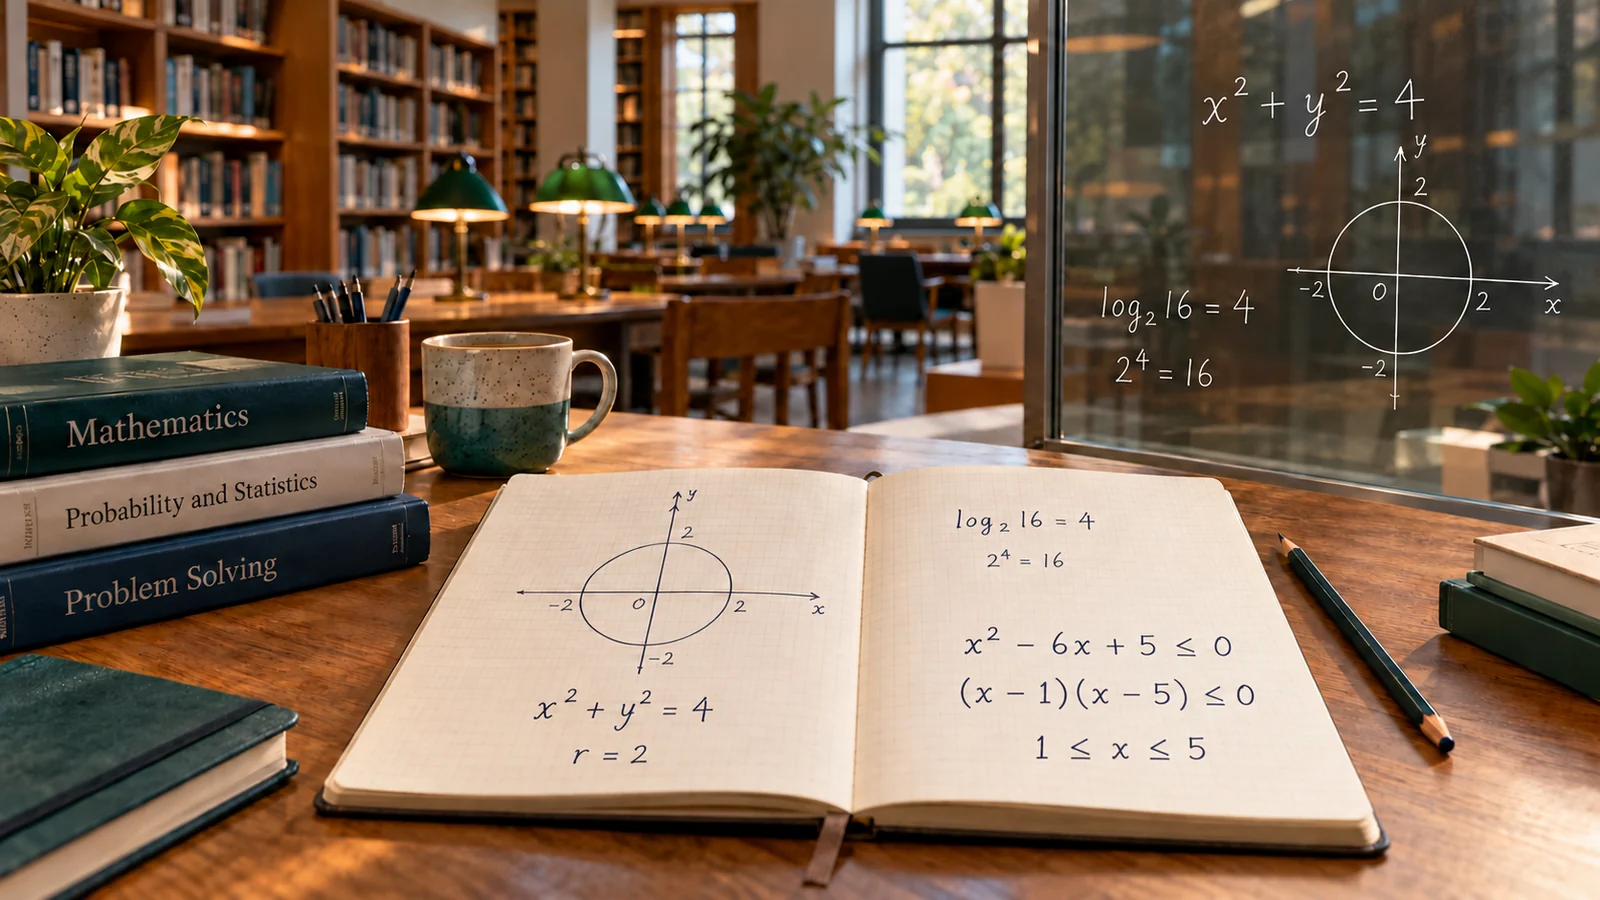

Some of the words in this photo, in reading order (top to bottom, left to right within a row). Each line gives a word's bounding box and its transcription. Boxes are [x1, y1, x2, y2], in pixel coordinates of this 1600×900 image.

[1260, 91, 1285, 119] +
[1358, 99, 1378, 113] =
[1394, 78, 1425, 121] 4
[1414, 134, 1427, 159] y
[1413, 176, 1428, 197] 2
[1165, 289, 1192, 320] 16
[1205, 303, 1220, 314] =
[1232, 288, 1255, 325] 4
[1475, 291, 1491, 311] 2
[1544, 298, 1562, 315] x
[1158, 369, 1173, 380] =
[1186, 358, 1213, 388] 16
[66, 403, 249, 448] Mathematics
[65, 493, 185, 530] Probability
[191, 482, 228, 509] and
[234, 474, 318, 502] Statistics
[687, 489, 698, 502] y
[1021, 510, 1043, 529] 16
[1055, 518, 1067, 526] =
[1078, 511, 1096, 531] 4
[680, 525, 694, 540] 2
[1043, 551, 1064, 569] 16
[64, 577, 178, 617] Problem
[187, 557, 278, 592] Solving
[733, 599, 747, 613] 2
[811, 604, 825, 615] x
[1105, 638, 1125, 656] +
[1140, 634, 1156, 657] 5
[586, 701, 605, 719] +
[662, 706, 678, 716] =
[691, 696, 714, 723] 4
[572, 748, 590, 765] r
[602, 751, 619, 761] =
[629, 744, 648, 765] 2
[1035, 734, 1049, 760] 1
[1111, 742, 1130, 760] x
[1188, 736, 1206, 761] 5
